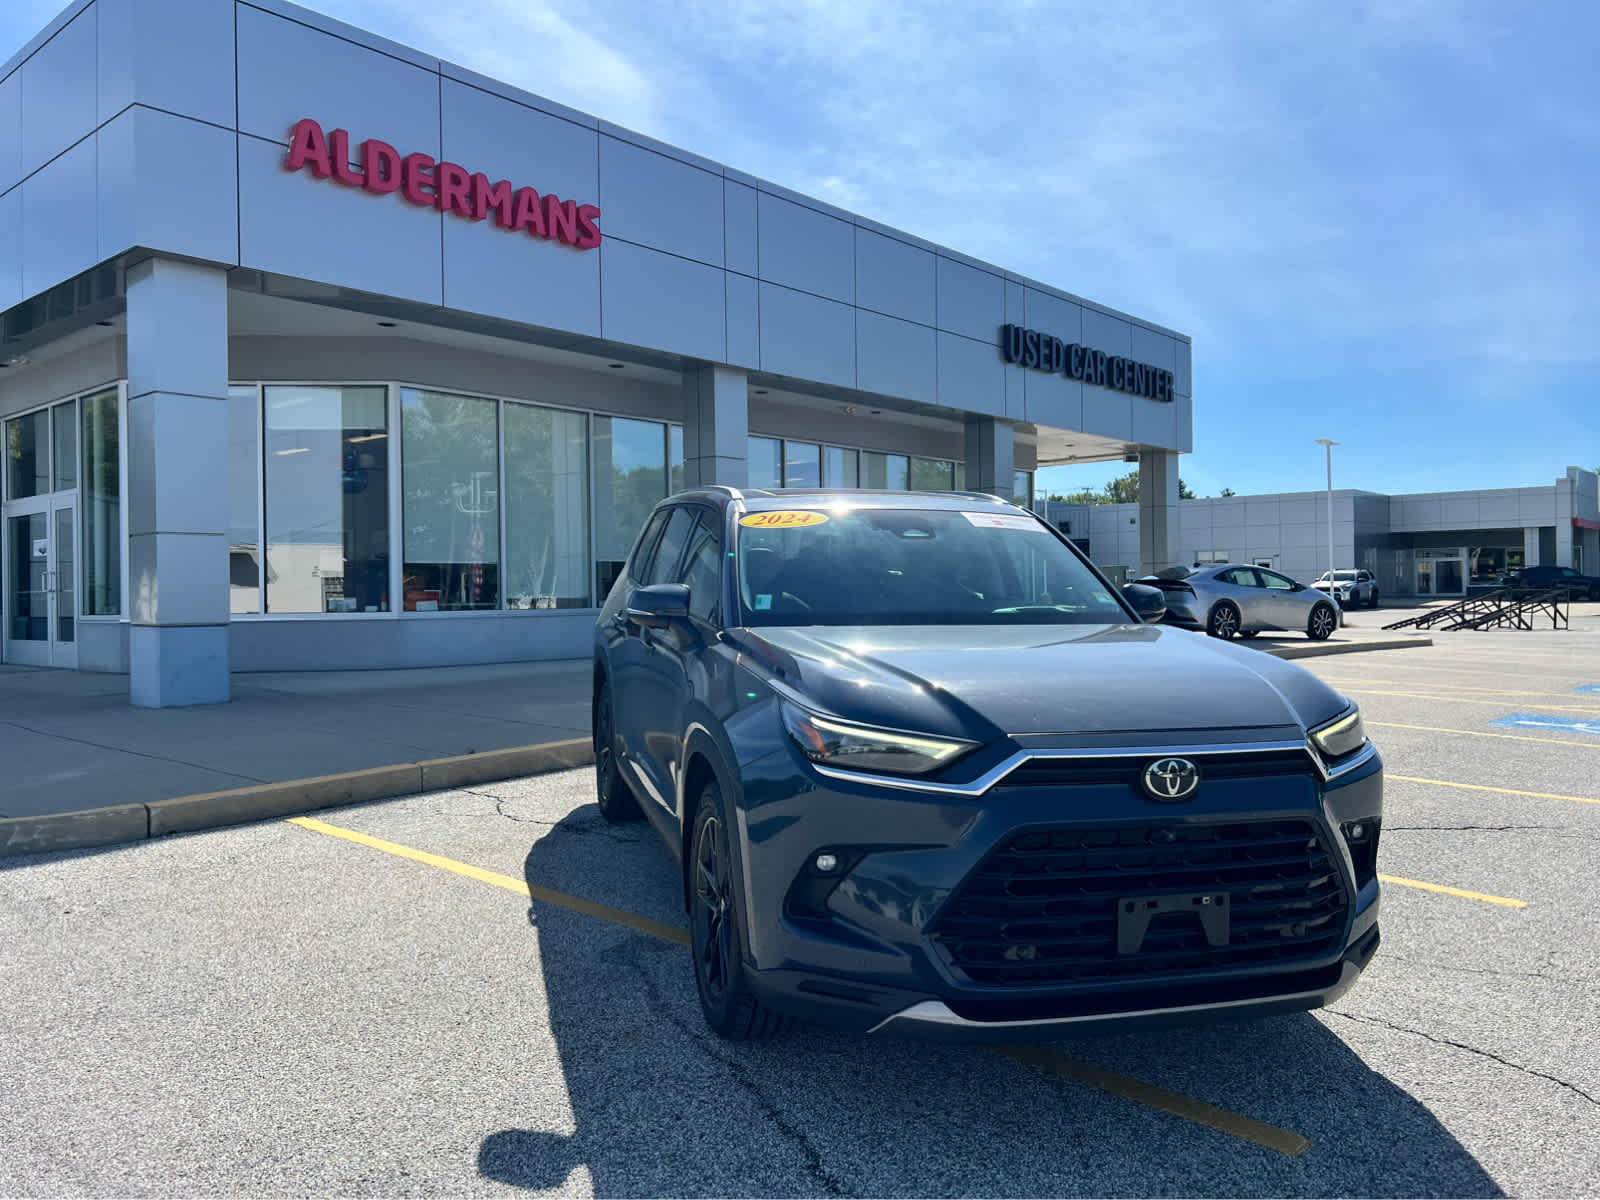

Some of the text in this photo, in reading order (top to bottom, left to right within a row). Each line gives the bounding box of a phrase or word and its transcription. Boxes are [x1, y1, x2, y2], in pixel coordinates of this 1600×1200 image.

[285, 118, 602, 250] ALDERMANS
[1003, 324, 1175, 402] USED CAR CENTER
[752, 513, 812, 527] 2024
